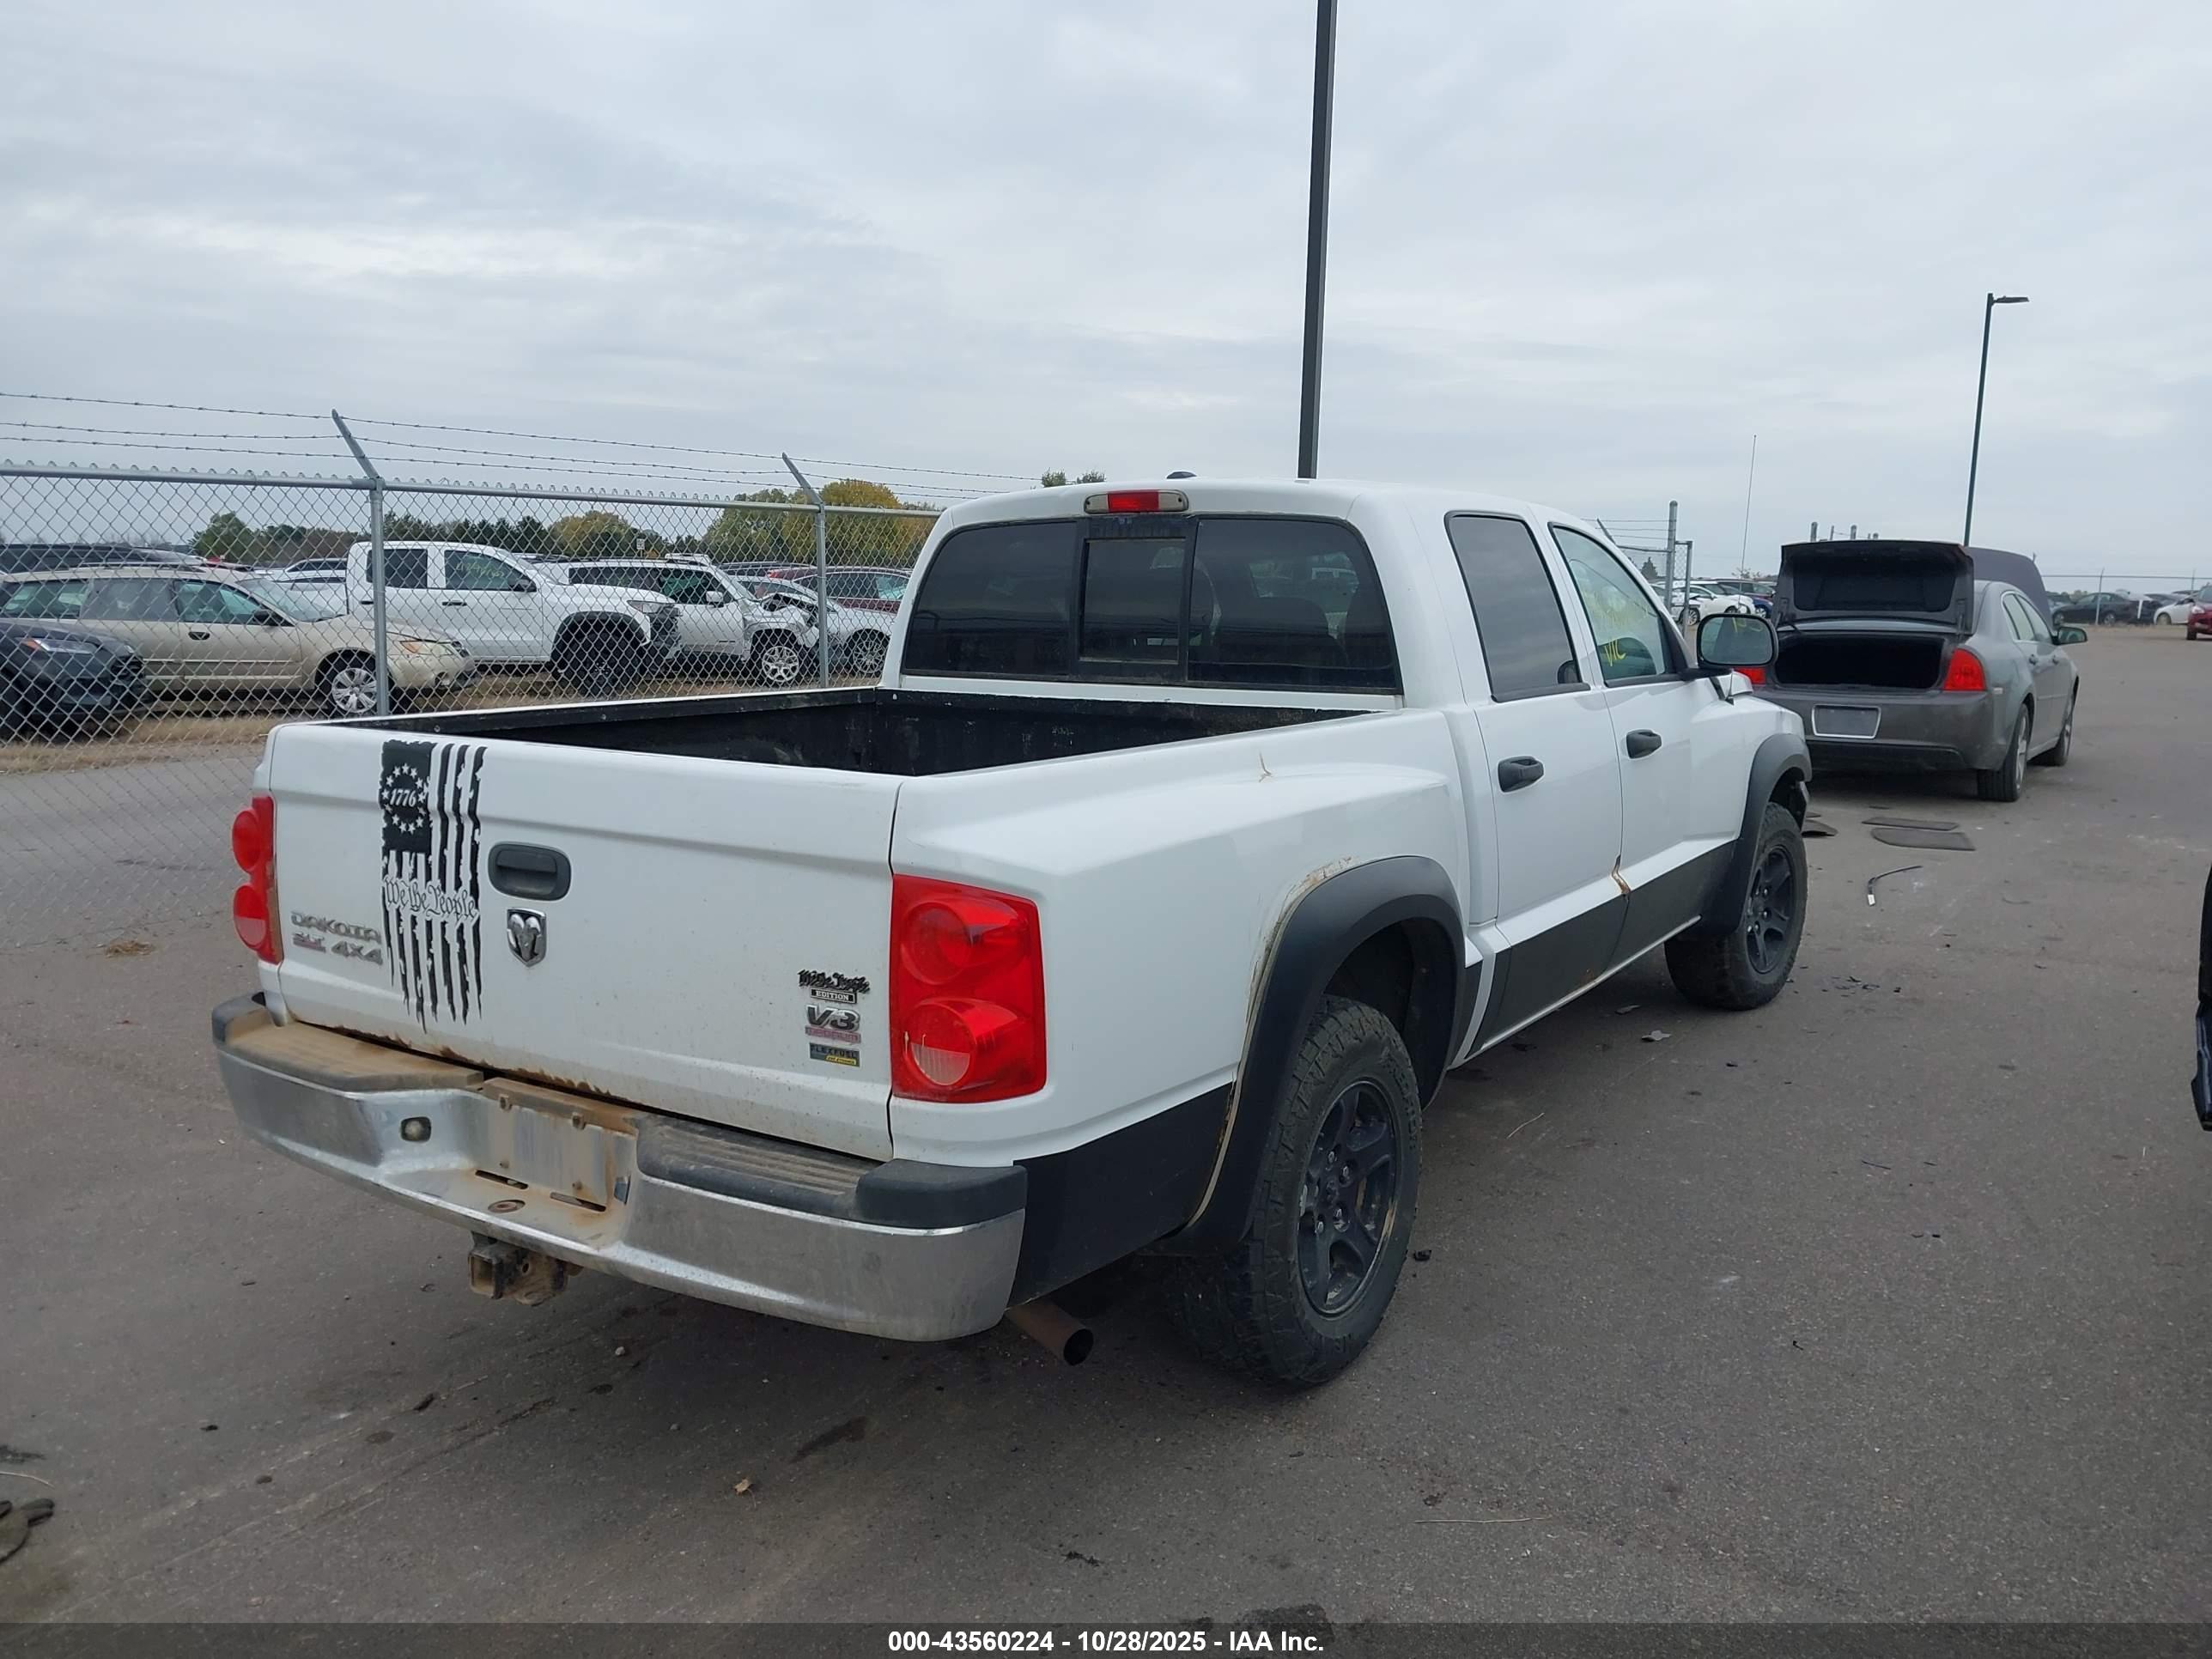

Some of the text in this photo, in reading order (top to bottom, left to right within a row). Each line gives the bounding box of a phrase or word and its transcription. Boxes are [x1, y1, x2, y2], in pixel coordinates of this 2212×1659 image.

[389, 788, 416, 807] 1776
[384, 876, 409, 907] We
[426, 884, 477, 921] People
[815, 990, 850, 1001] EDITION
